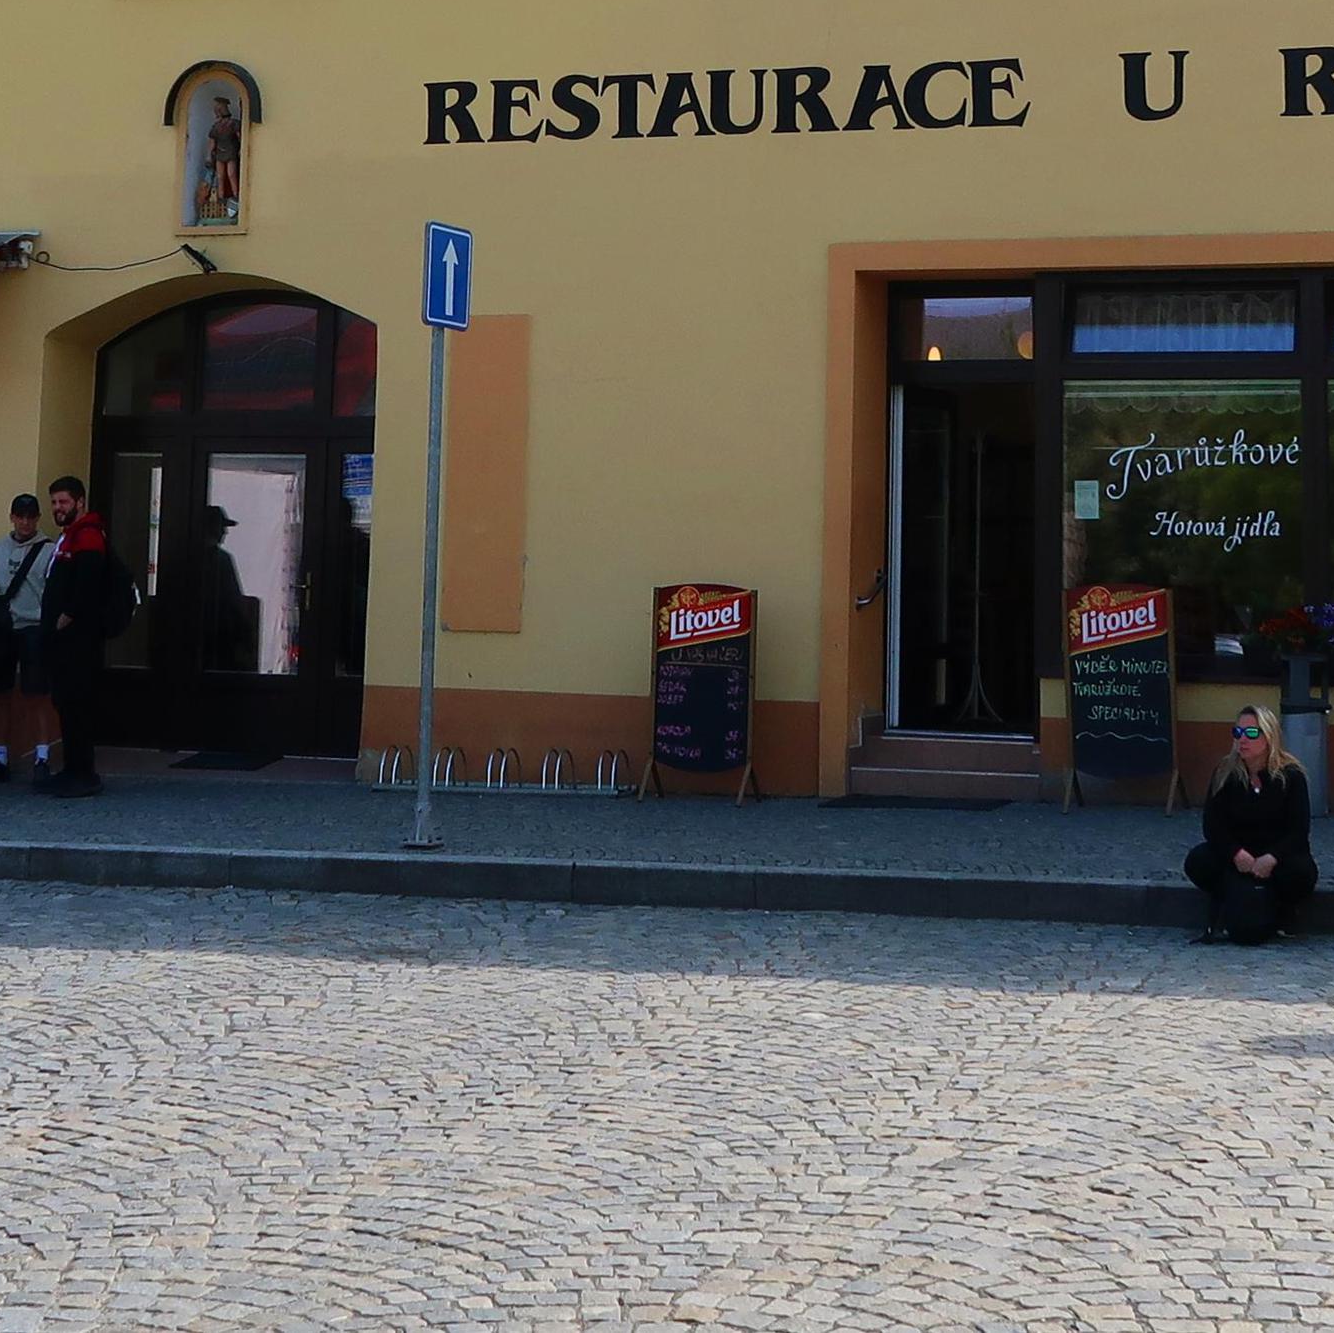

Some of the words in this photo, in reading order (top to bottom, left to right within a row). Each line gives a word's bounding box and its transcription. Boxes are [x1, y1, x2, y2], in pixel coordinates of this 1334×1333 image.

[423, 58, 1031, 145] RESTAURACE
[1118, 50, 1190, 121] U
[1105, 428, 1301, 500] Tvarůžkové
[1149, 511, 1226, 538] Hotová
[1223, 510, 1281, 552] jídla
[669, 599, 741, 640] Litovel
[1081, 598, 1157, 643] Litovel
[1075, 654, 1118, 675] VÝBĚR
[1087, 705, 1159, 726] SPECIALITY
